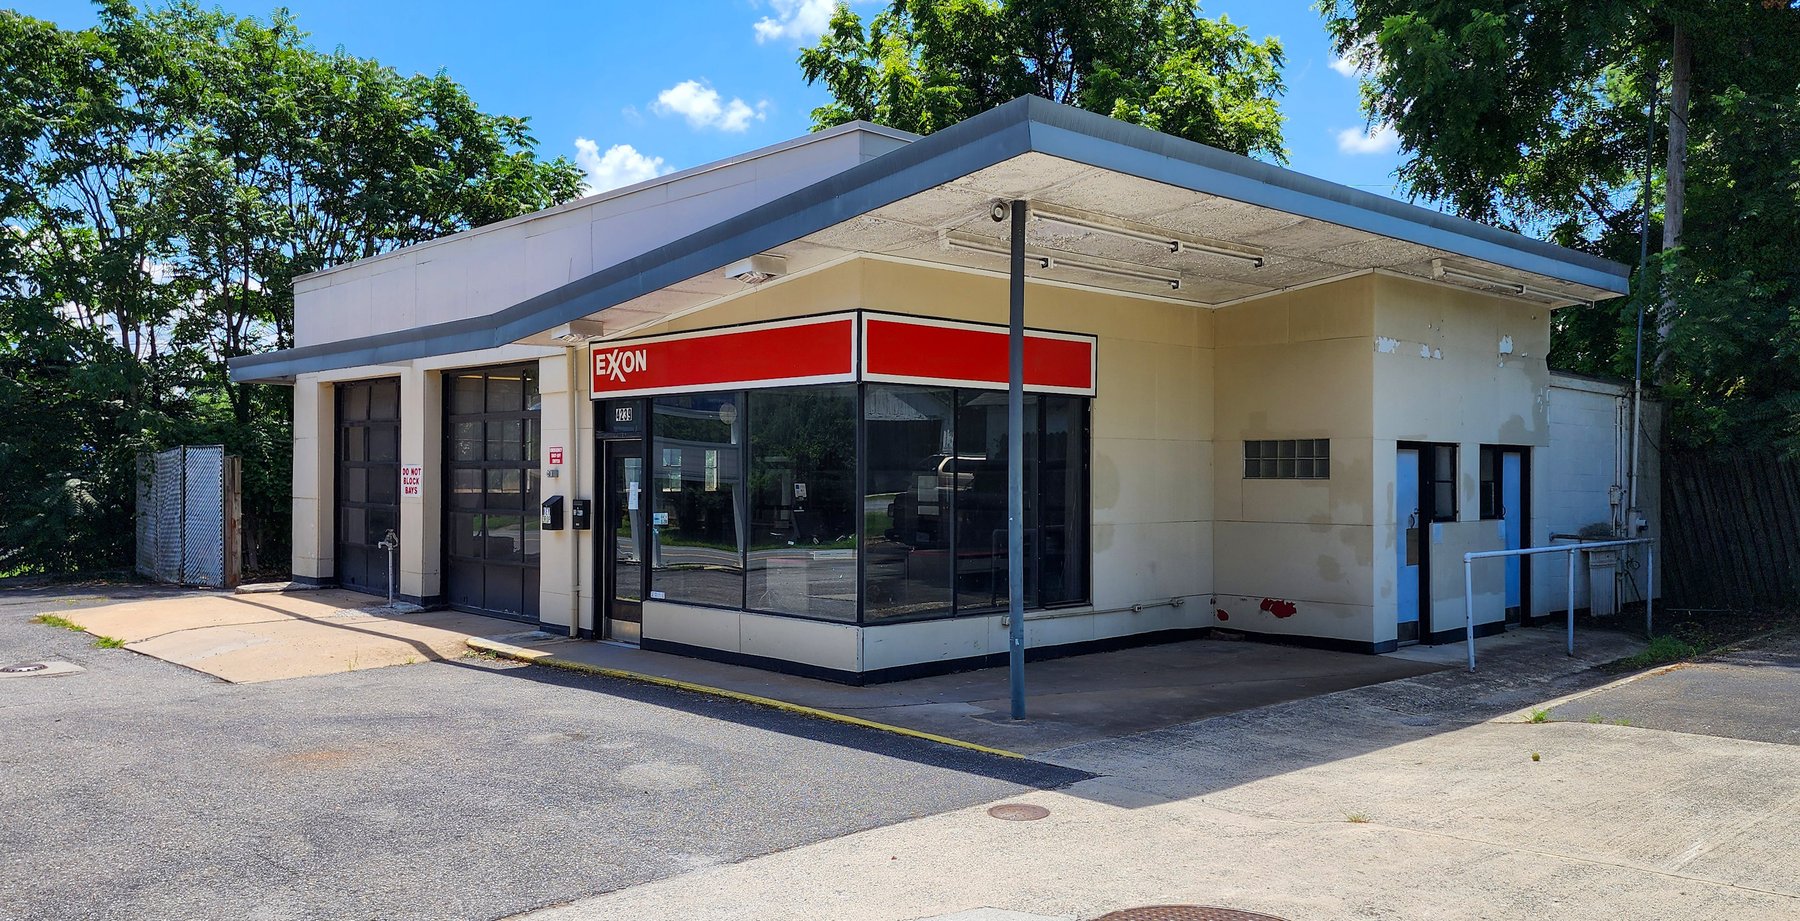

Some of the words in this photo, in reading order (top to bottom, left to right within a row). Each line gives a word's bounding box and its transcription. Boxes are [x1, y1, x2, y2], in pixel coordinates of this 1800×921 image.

[596, 349, 647, 382] EXXON
[616, 407, 632, 422] 4239
[402, 468, 410, 476] DO
[411, 468, 421, 476] NOT
[403, 477, 420, 485] BLOCK
[404, 487, 418, 495] BAYS
